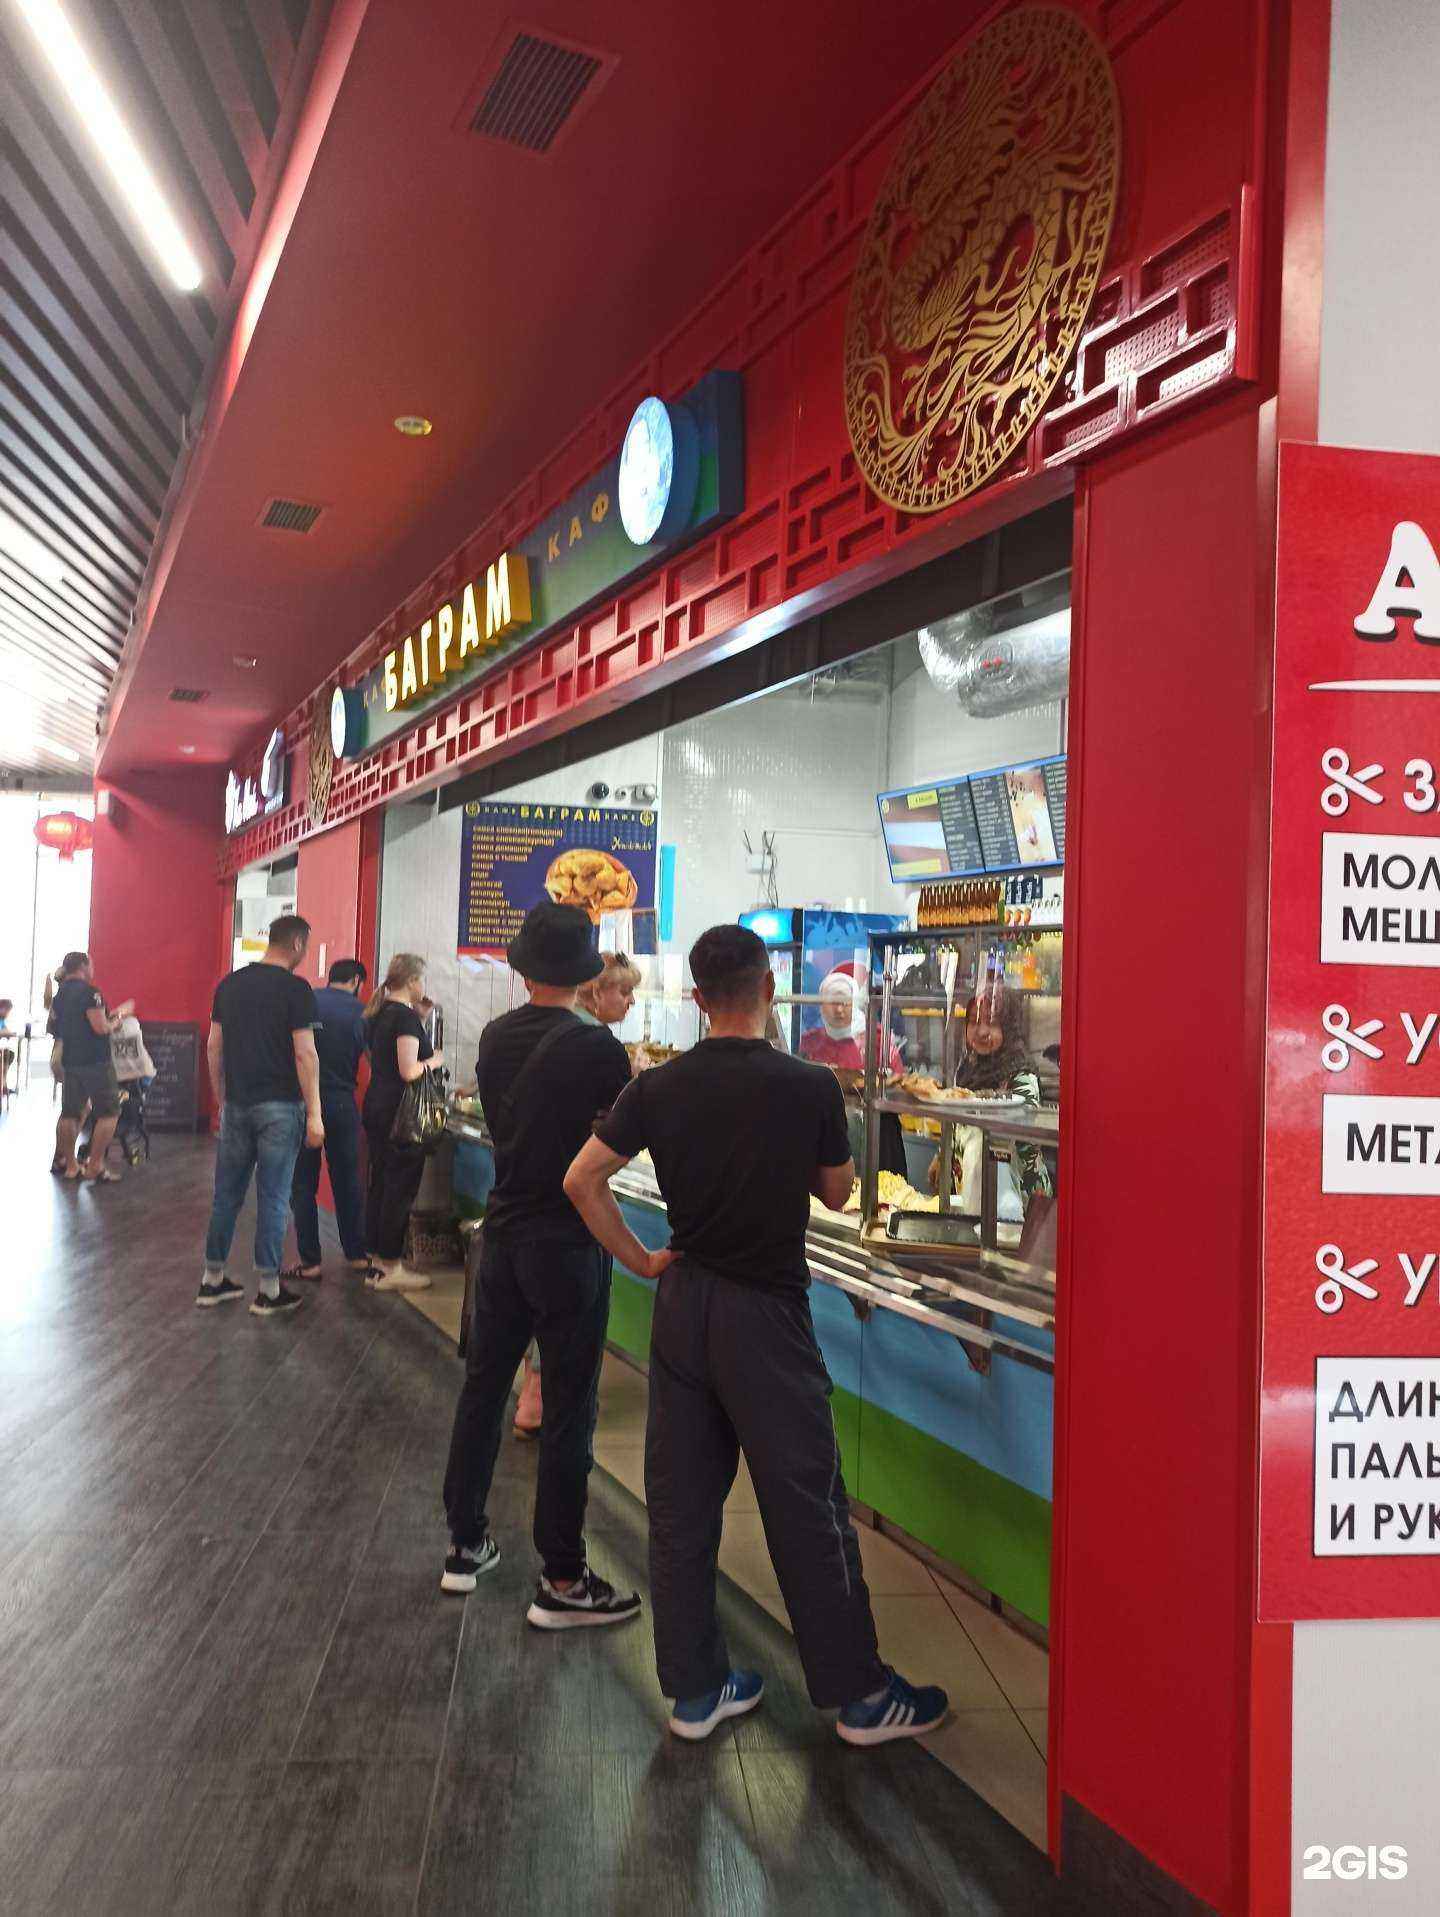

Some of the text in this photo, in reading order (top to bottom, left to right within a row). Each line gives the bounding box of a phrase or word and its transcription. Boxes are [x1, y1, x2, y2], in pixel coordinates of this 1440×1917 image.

[384, 551, 513, 713] БАГРАМ
[1403, 758, 1440, 813] З
[520, 805, 600, 822] БАГРАМ
[1400, 1011, 1440, 1064] У
[1347, 1122, 1440, 1164] МЕТ
[1397, 1252, 1440, 1307] У
[1330, 1503, 1355, 1540] И
